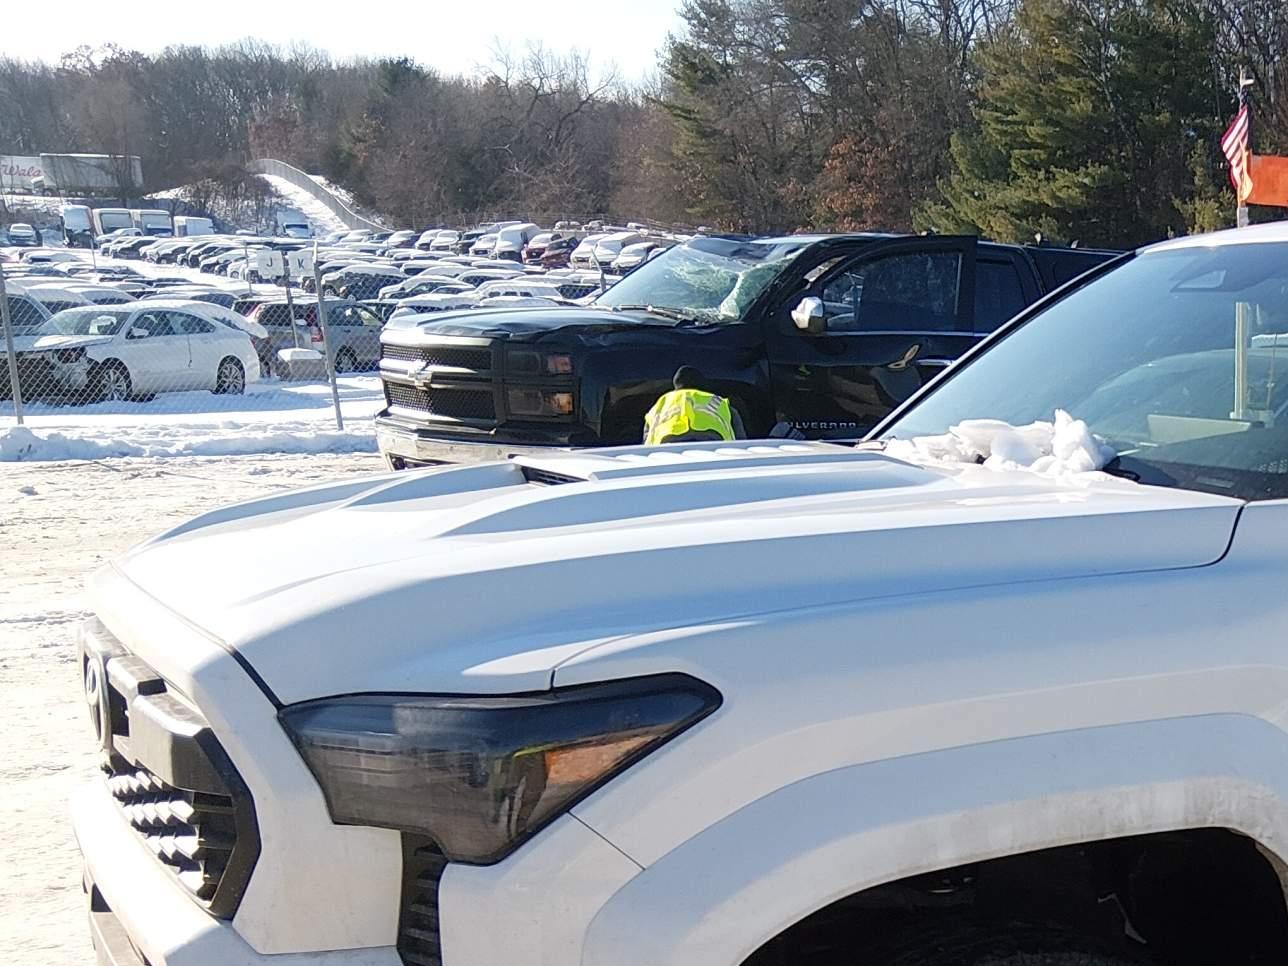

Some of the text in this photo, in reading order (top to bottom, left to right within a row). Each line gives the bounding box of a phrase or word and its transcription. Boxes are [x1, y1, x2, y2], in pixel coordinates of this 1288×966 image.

[266, 257, 273, 267] J
[297, 257, 305, 269] K
[787, 421, 857, 430] ILVERADO
